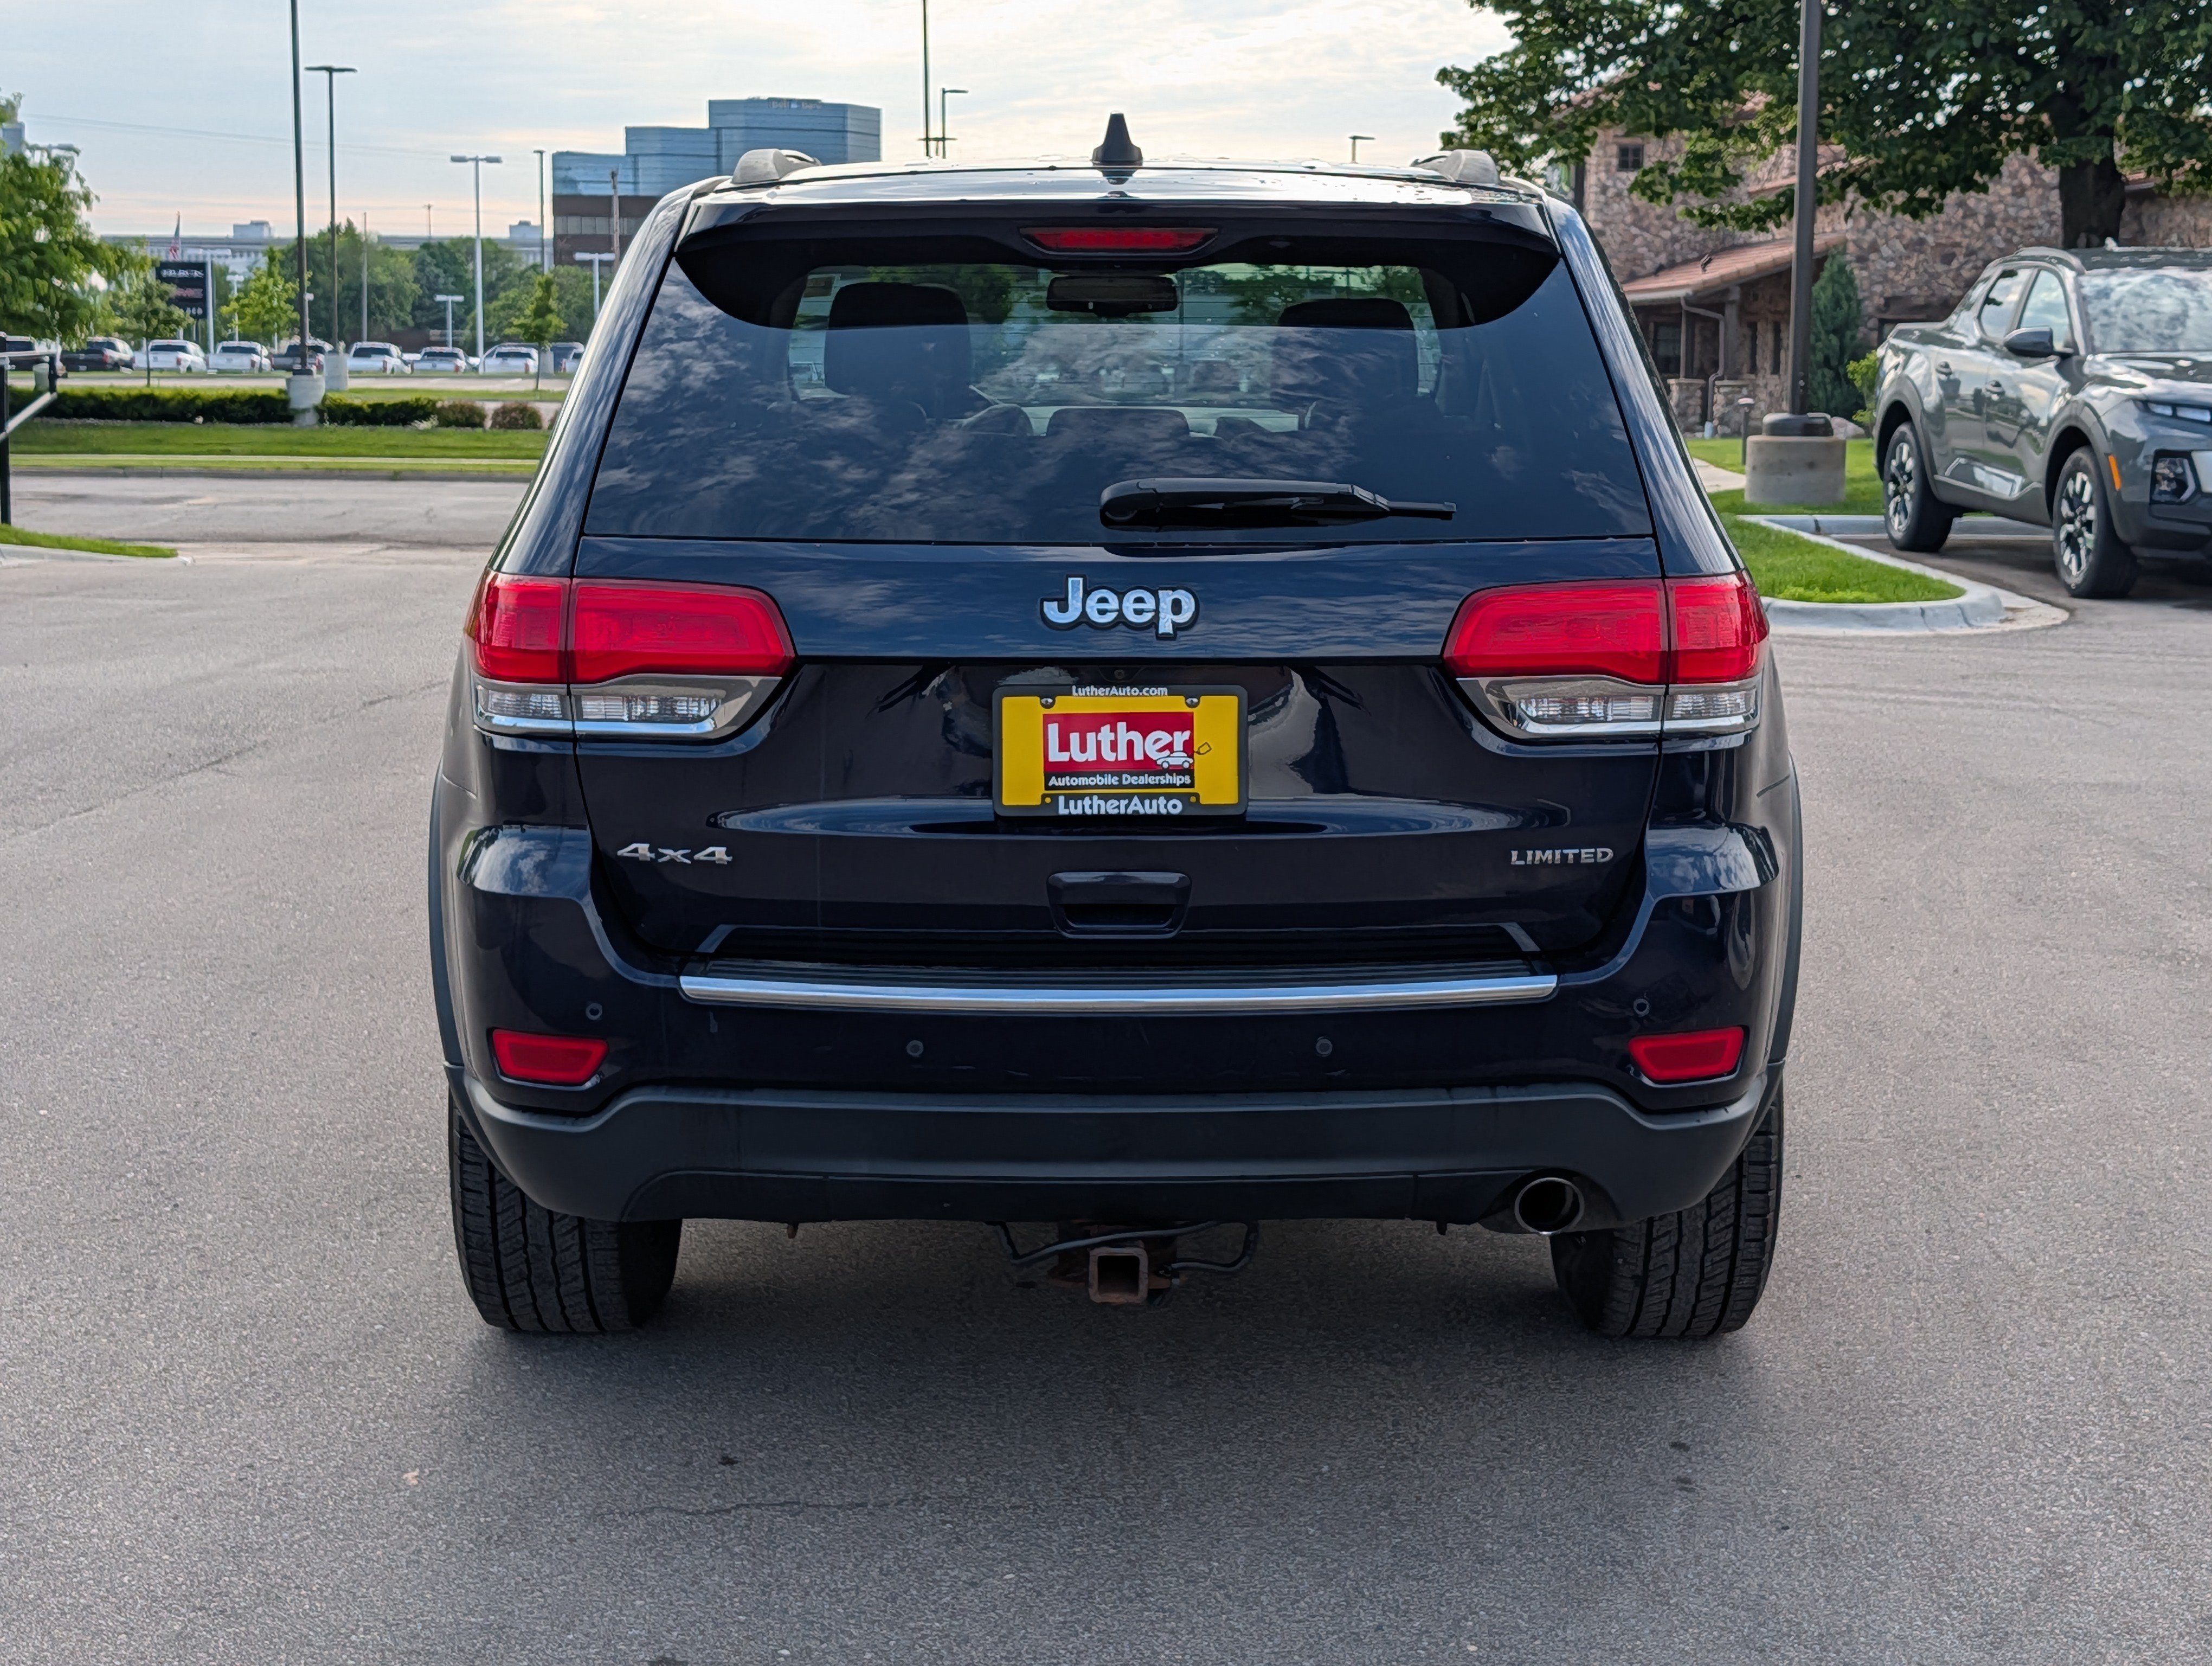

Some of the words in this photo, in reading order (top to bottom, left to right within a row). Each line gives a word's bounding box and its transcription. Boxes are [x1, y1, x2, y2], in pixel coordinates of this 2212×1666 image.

[1043, 576, 1196, 635] Jeep
[1072, 684, 1168, 697] LutherAuto.com
[1047, 721, 1191, 762] Luther
[1048, 774, 1119, 786] Automobile
[1122, 773, 1191, 786] Dealerships
[1058, 794, 1183, 815] LutherAuto
[616, 842, 733, 865] 4x4
[1510, 847, 1614, 865] LIMITED
